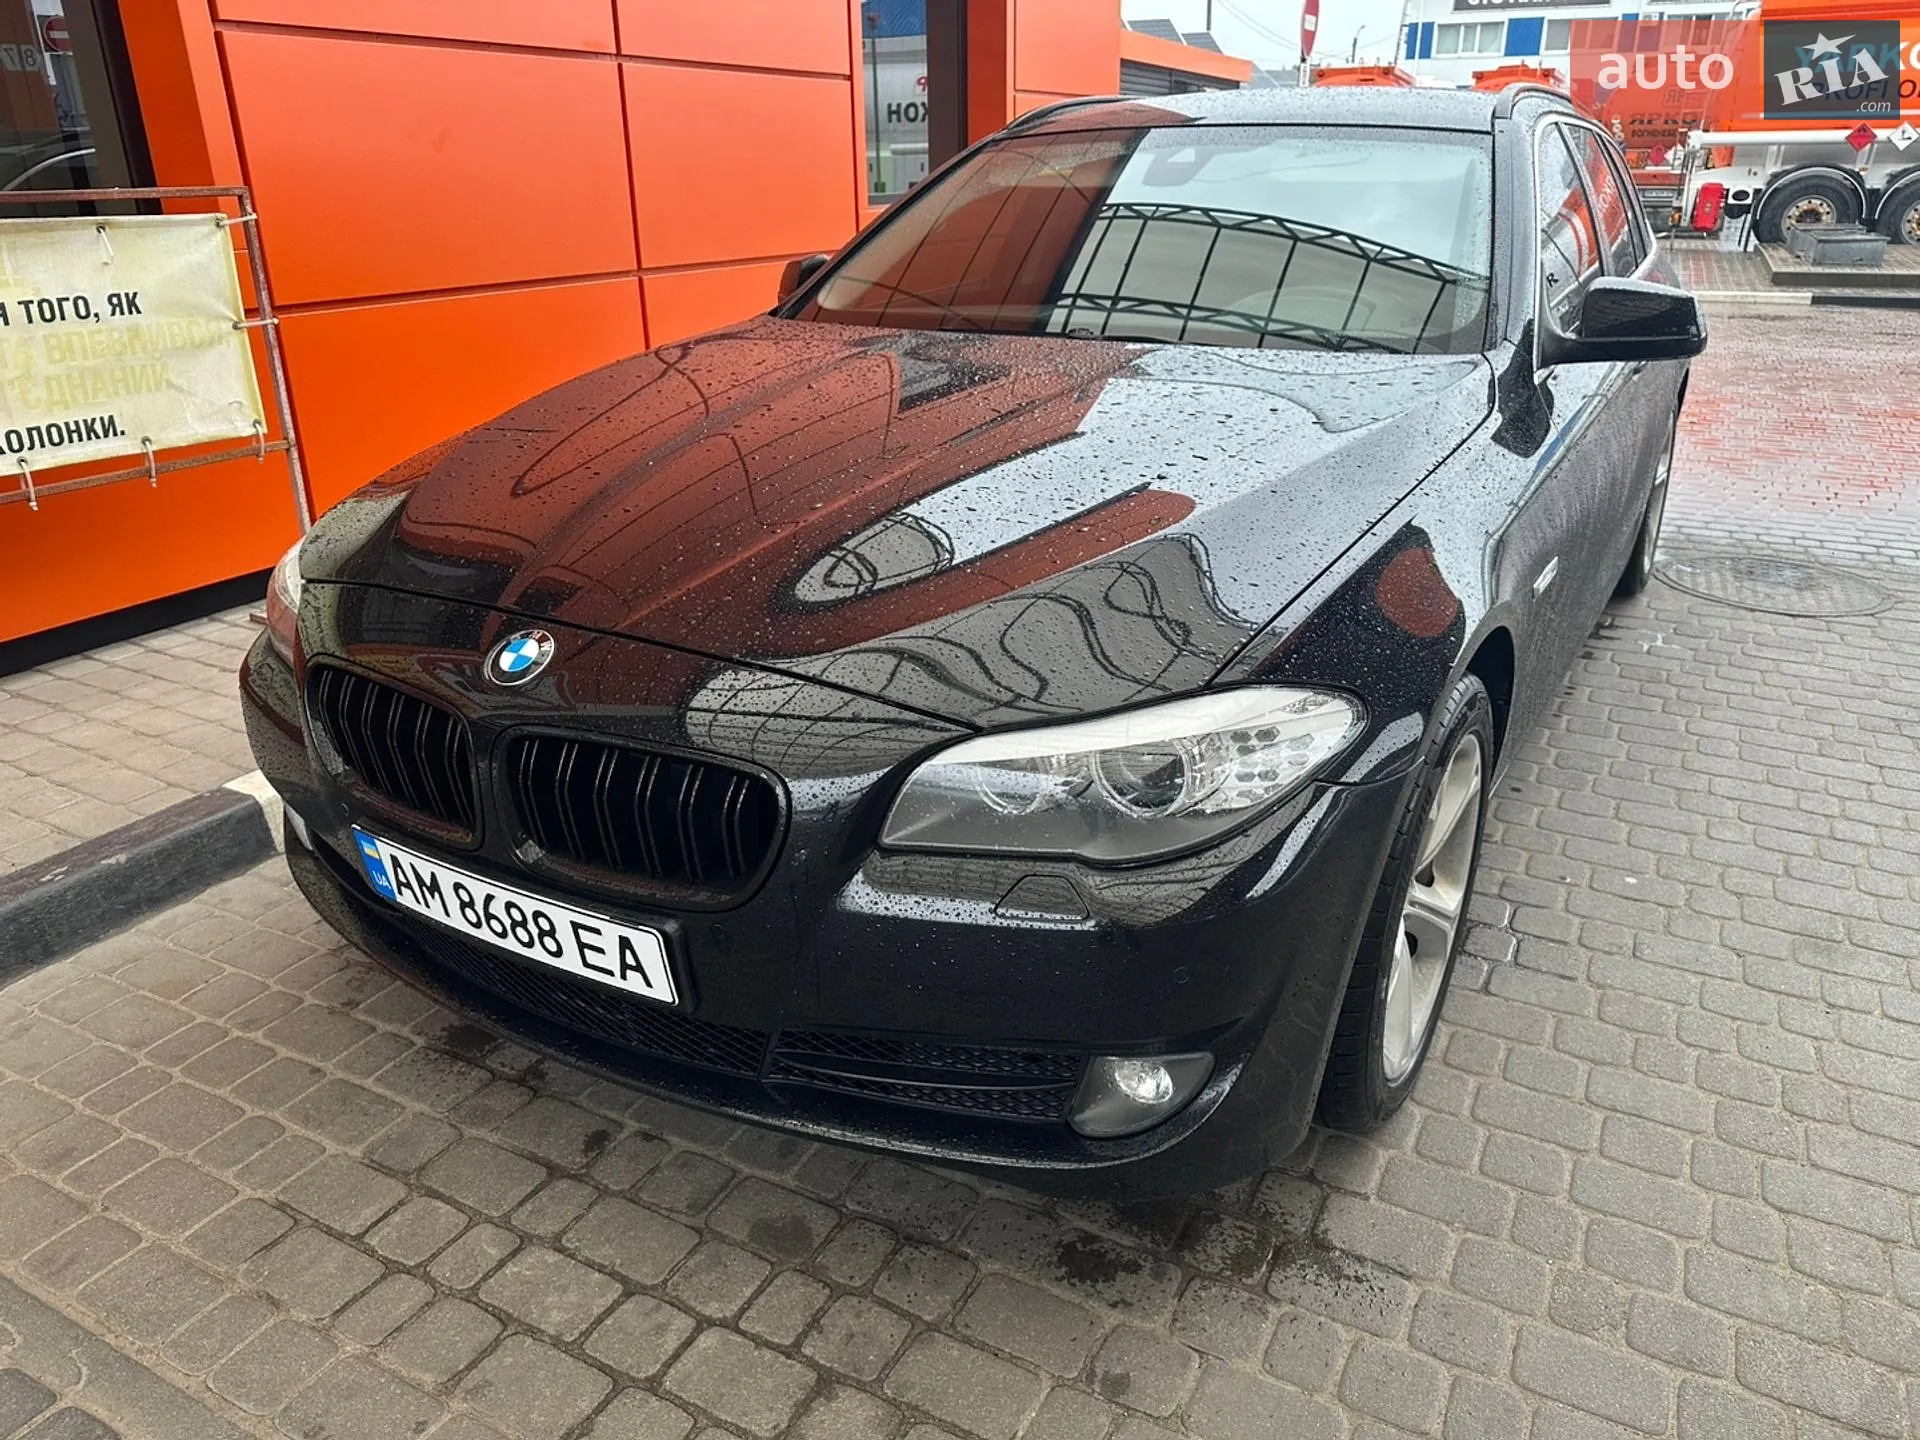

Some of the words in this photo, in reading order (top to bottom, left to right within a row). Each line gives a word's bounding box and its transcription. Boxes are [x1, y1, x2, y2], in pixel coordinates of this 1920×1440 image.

[1896, 79, 1920, 98] O
[18, 295, 100, 324] ТОГО,
[107, 291, 143, 317] ЯК
[372, 870, 392, 890] UA
[390, 853, 451, 918] AM
[453, 881, 563, 958] 8688
[569, 920, 653, 989] EA
